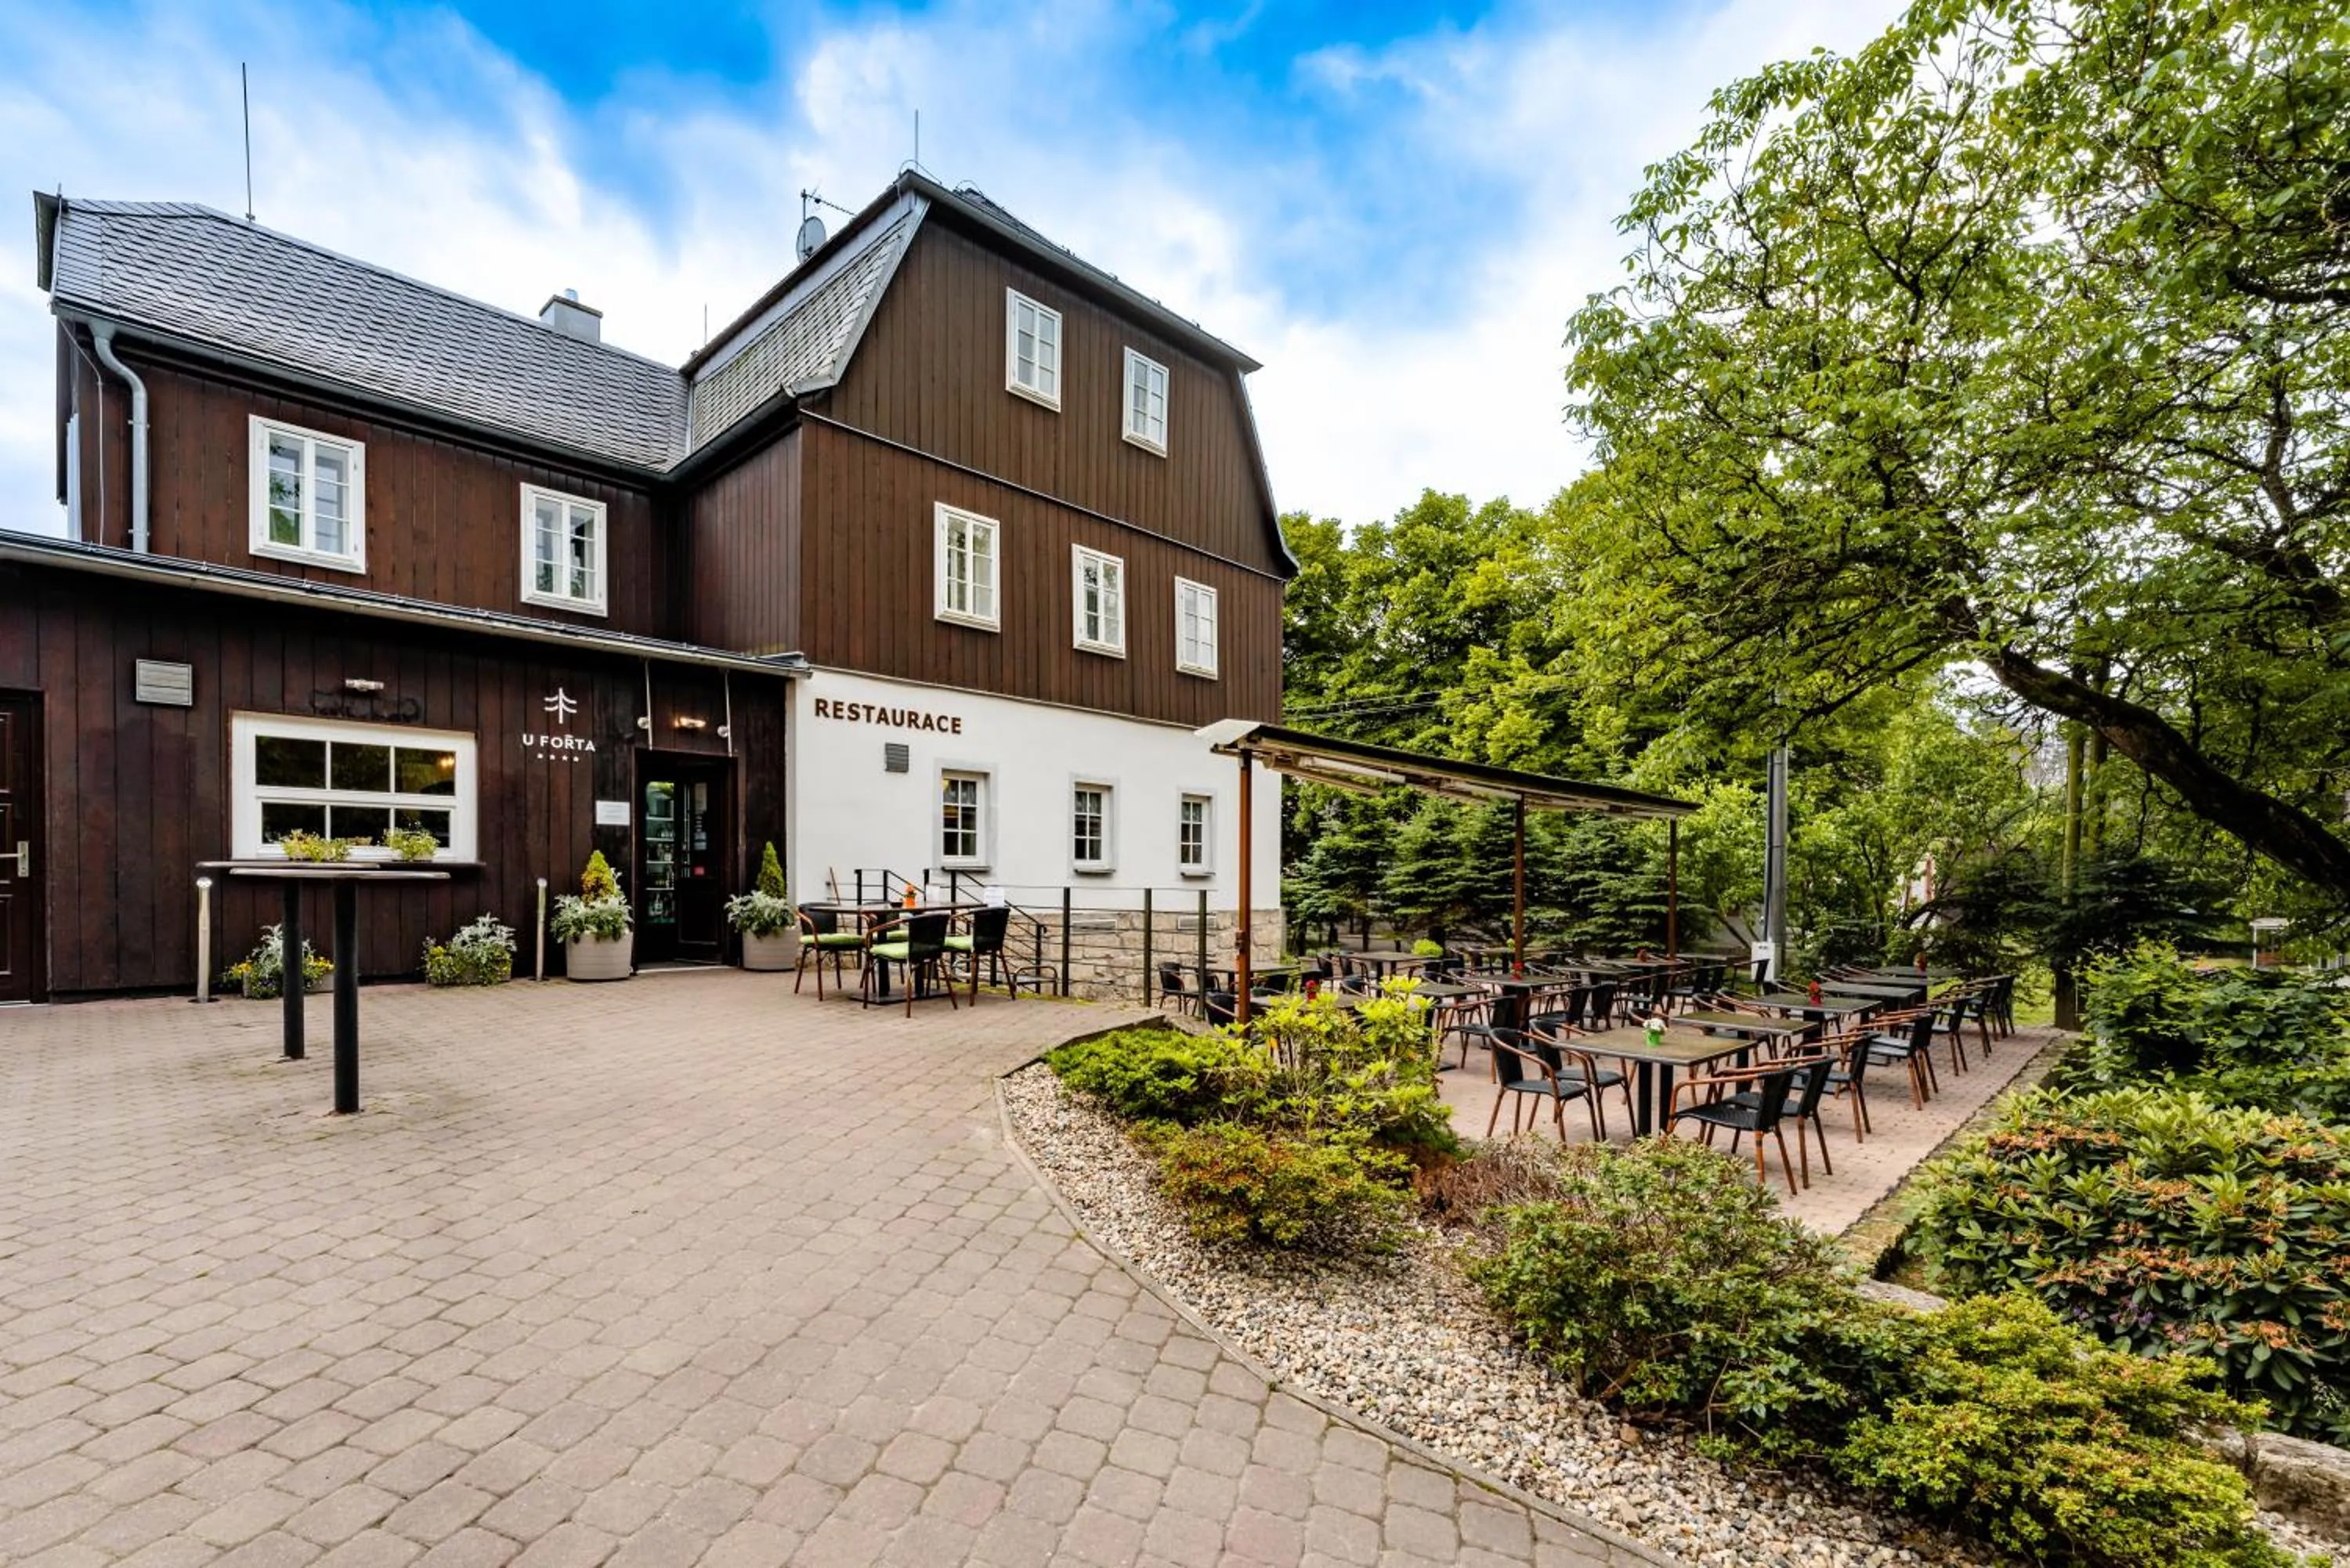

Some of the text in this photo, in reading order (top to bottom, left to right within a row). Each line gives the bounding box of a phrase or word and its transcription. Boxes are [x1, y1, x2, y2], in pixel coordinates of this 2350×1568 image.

[815, 698, 962, 735] RESTAURACE
[522, 733, 595, 752] U FOŘTA
